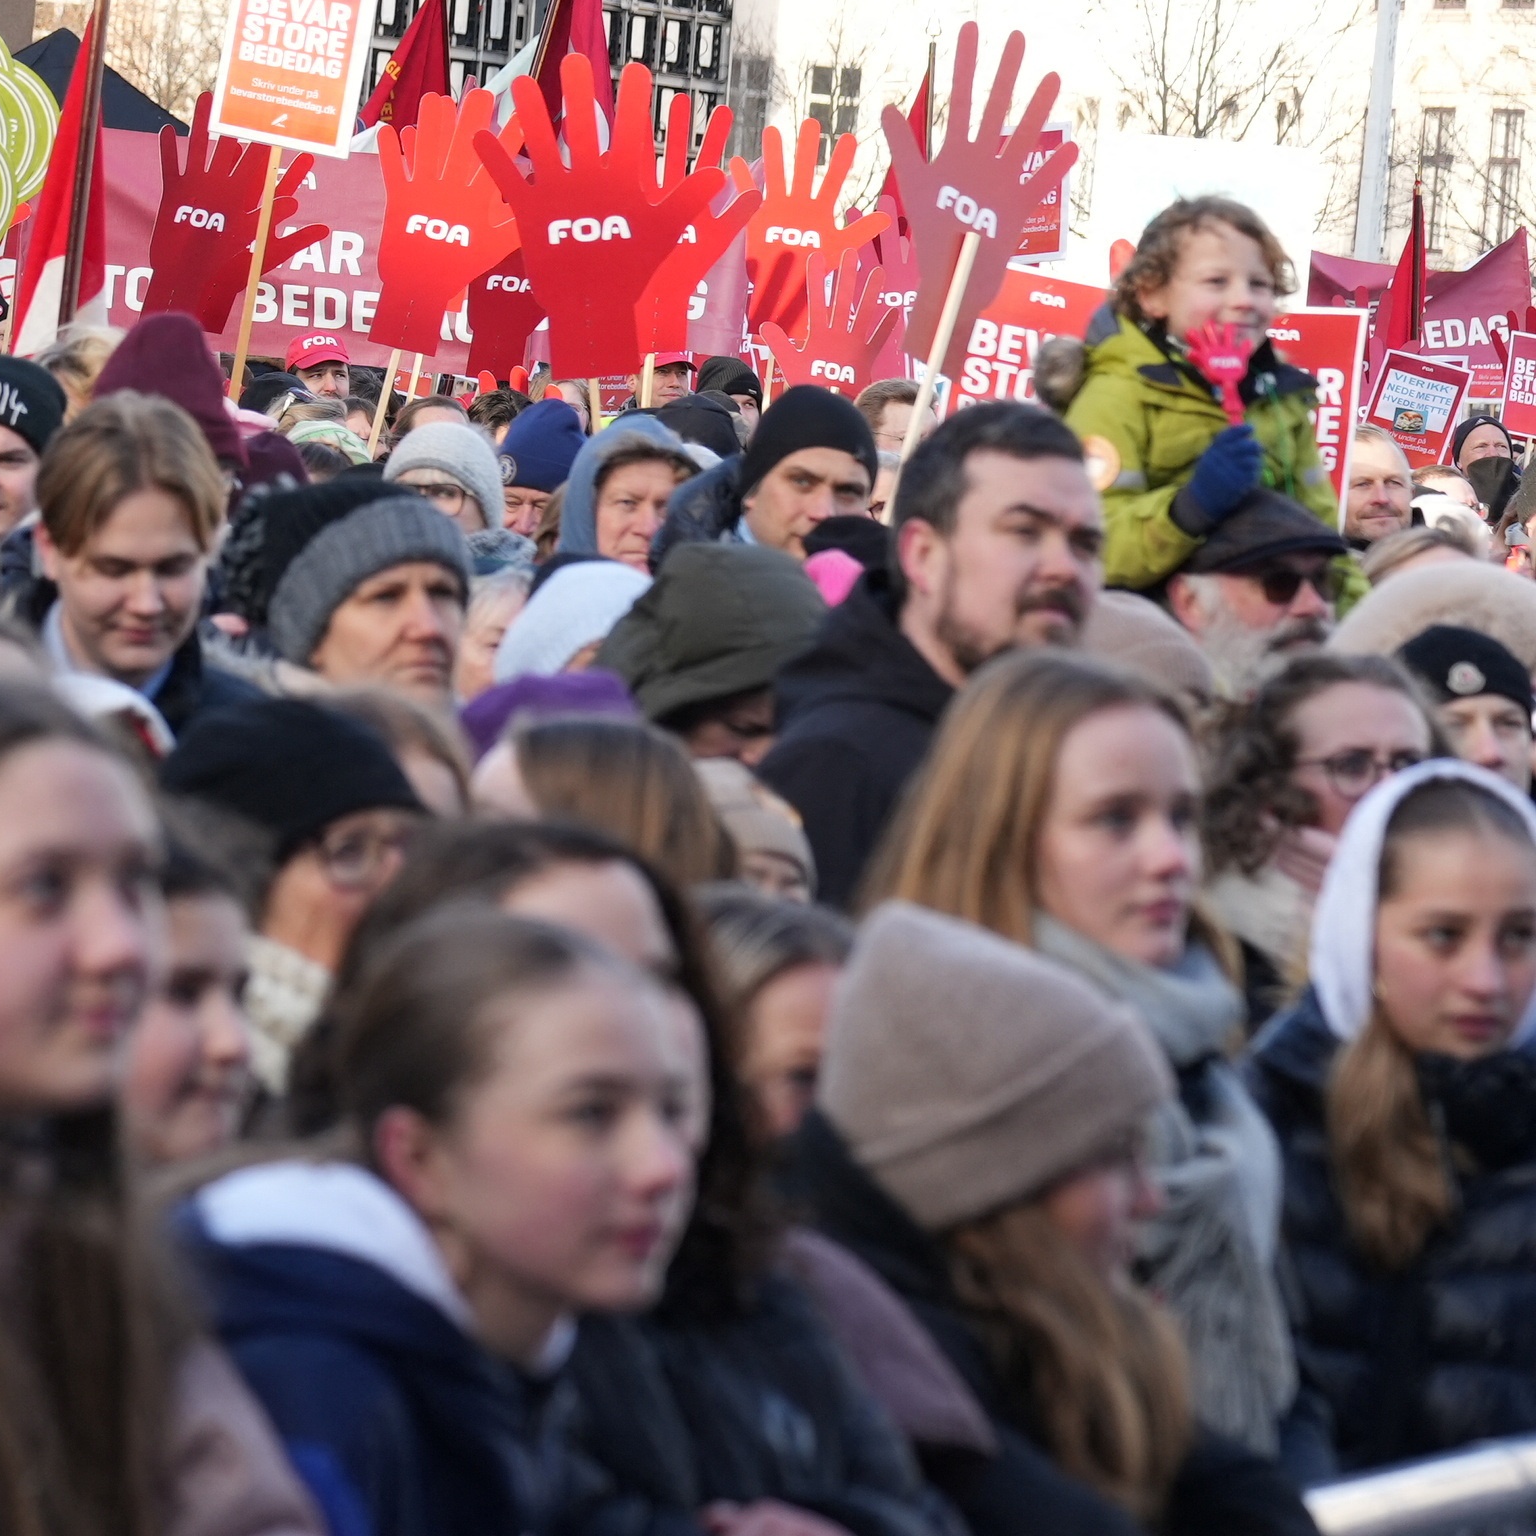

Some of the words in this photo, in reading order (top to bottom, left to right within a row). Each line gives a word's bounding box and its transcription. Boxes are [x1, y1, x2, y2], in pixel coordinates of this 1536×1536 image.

[242, 13, 347, 59] STORE
[238, 41, 342, 79] BEDEDAG
[230, 85, 336, 115] bevarstorebededag.dk
[251, 77, 275, 89] Skriv
[276, 82, 305, 96] under
[305, 87, 319, 99] på
[174, 205, 226, 233] FOA
[936, 185, 997, 239] FOA
[406, 214, 470, 247] FOA
[548, 215, 631, 245] FOA
[766, 225, 820, 248] FOA
[1030, 291, 1066, 308] FOA
[302, 335, 338, 350] FOA
[967, 318, 1056, 364] BEV
[1420, 314, 1510, 349] EDAG
[811, 359, 855, 384] FOA
[961, 357, 1036, 402] STO
[1395, 372, 1407, 383] VI
[1408, 375, 1426, 388] ER
[1382, 393, 1416, 410] HVEDE
[1416, 402, 1449, 416] METTE
[1387, 382, 1415, 398] NEDE
[1416, 391, 1452, 406] METTE
